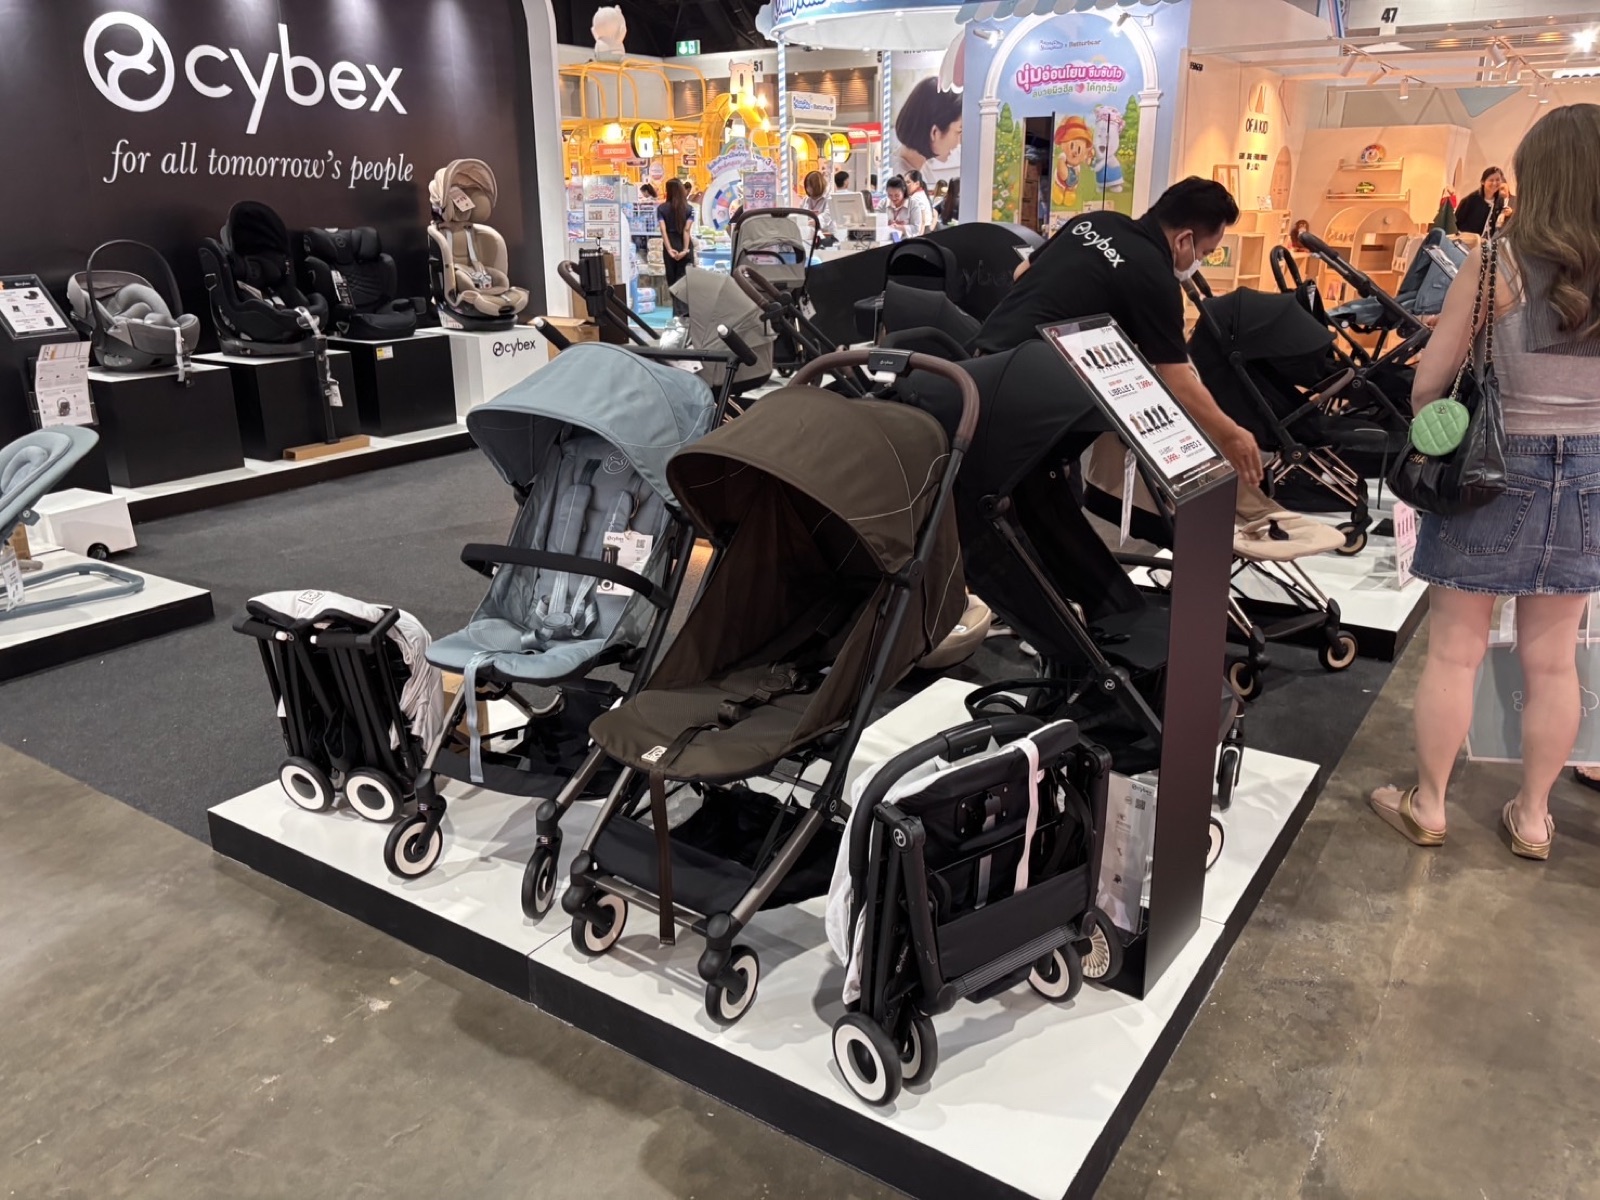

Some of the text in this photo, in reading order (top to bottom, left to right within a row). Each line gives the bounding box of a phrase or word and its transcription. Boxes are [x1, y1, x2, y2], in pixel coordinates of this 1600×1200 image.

[1381, 7, 1399, 23] 47
[184, 22, 408, 135] cybex
[753, 60, 763, 72] 51
[103, 139, 151, 184] for
[160, 142, 198, 175] all
[349, 154, 414, 190] people
[1083, 231, 1125, 268] cybex
[504, 338, 536, 357] cybex
